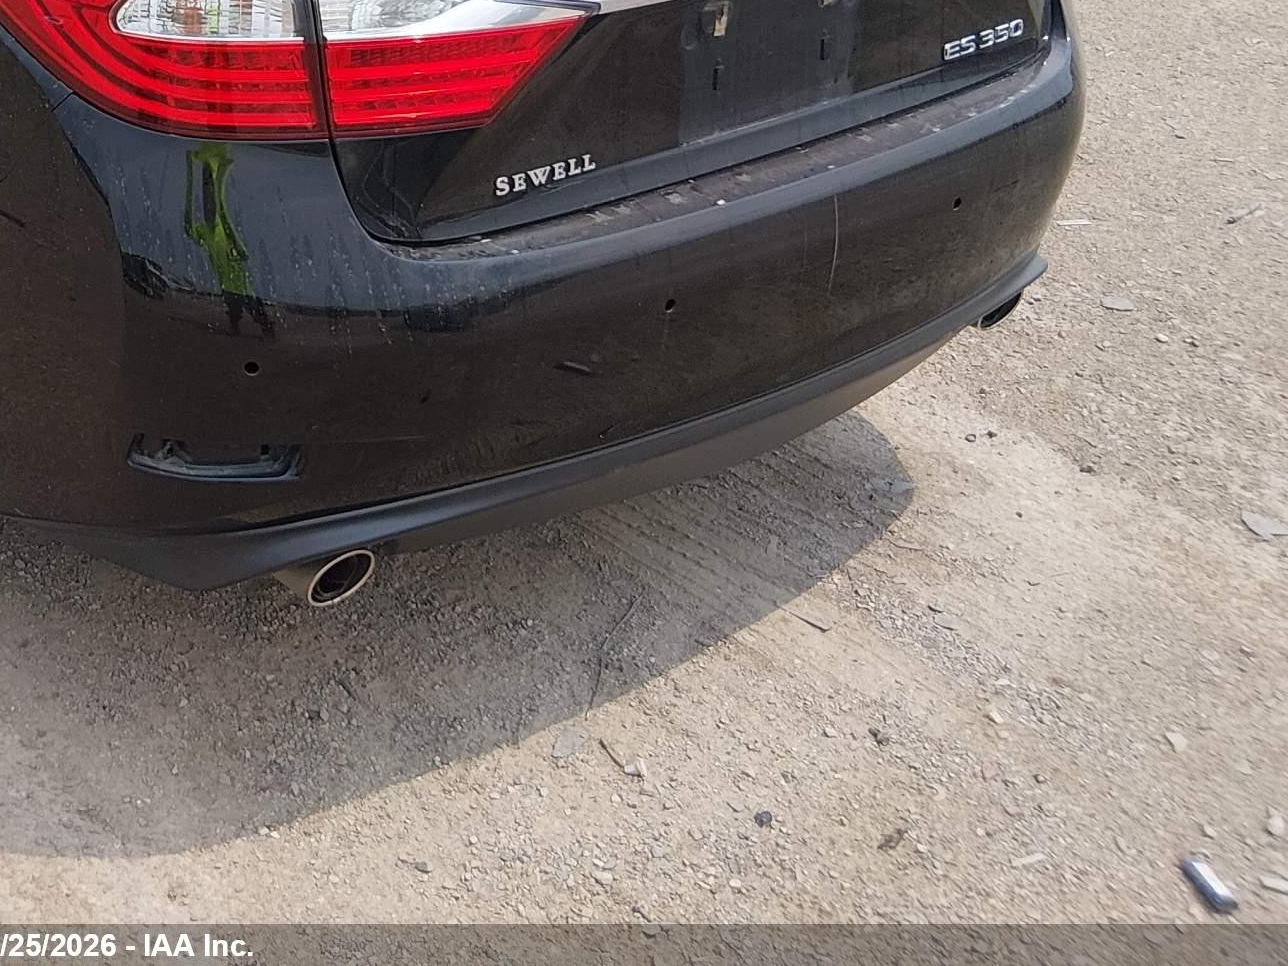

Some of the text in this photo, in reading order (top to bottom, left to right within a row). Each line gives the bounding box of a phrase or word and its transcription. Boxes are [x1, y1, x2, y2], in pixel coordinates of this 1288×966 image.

[943, 18, 1024, 61] ES 350
[495, 154, 596, 196] SEWELL
